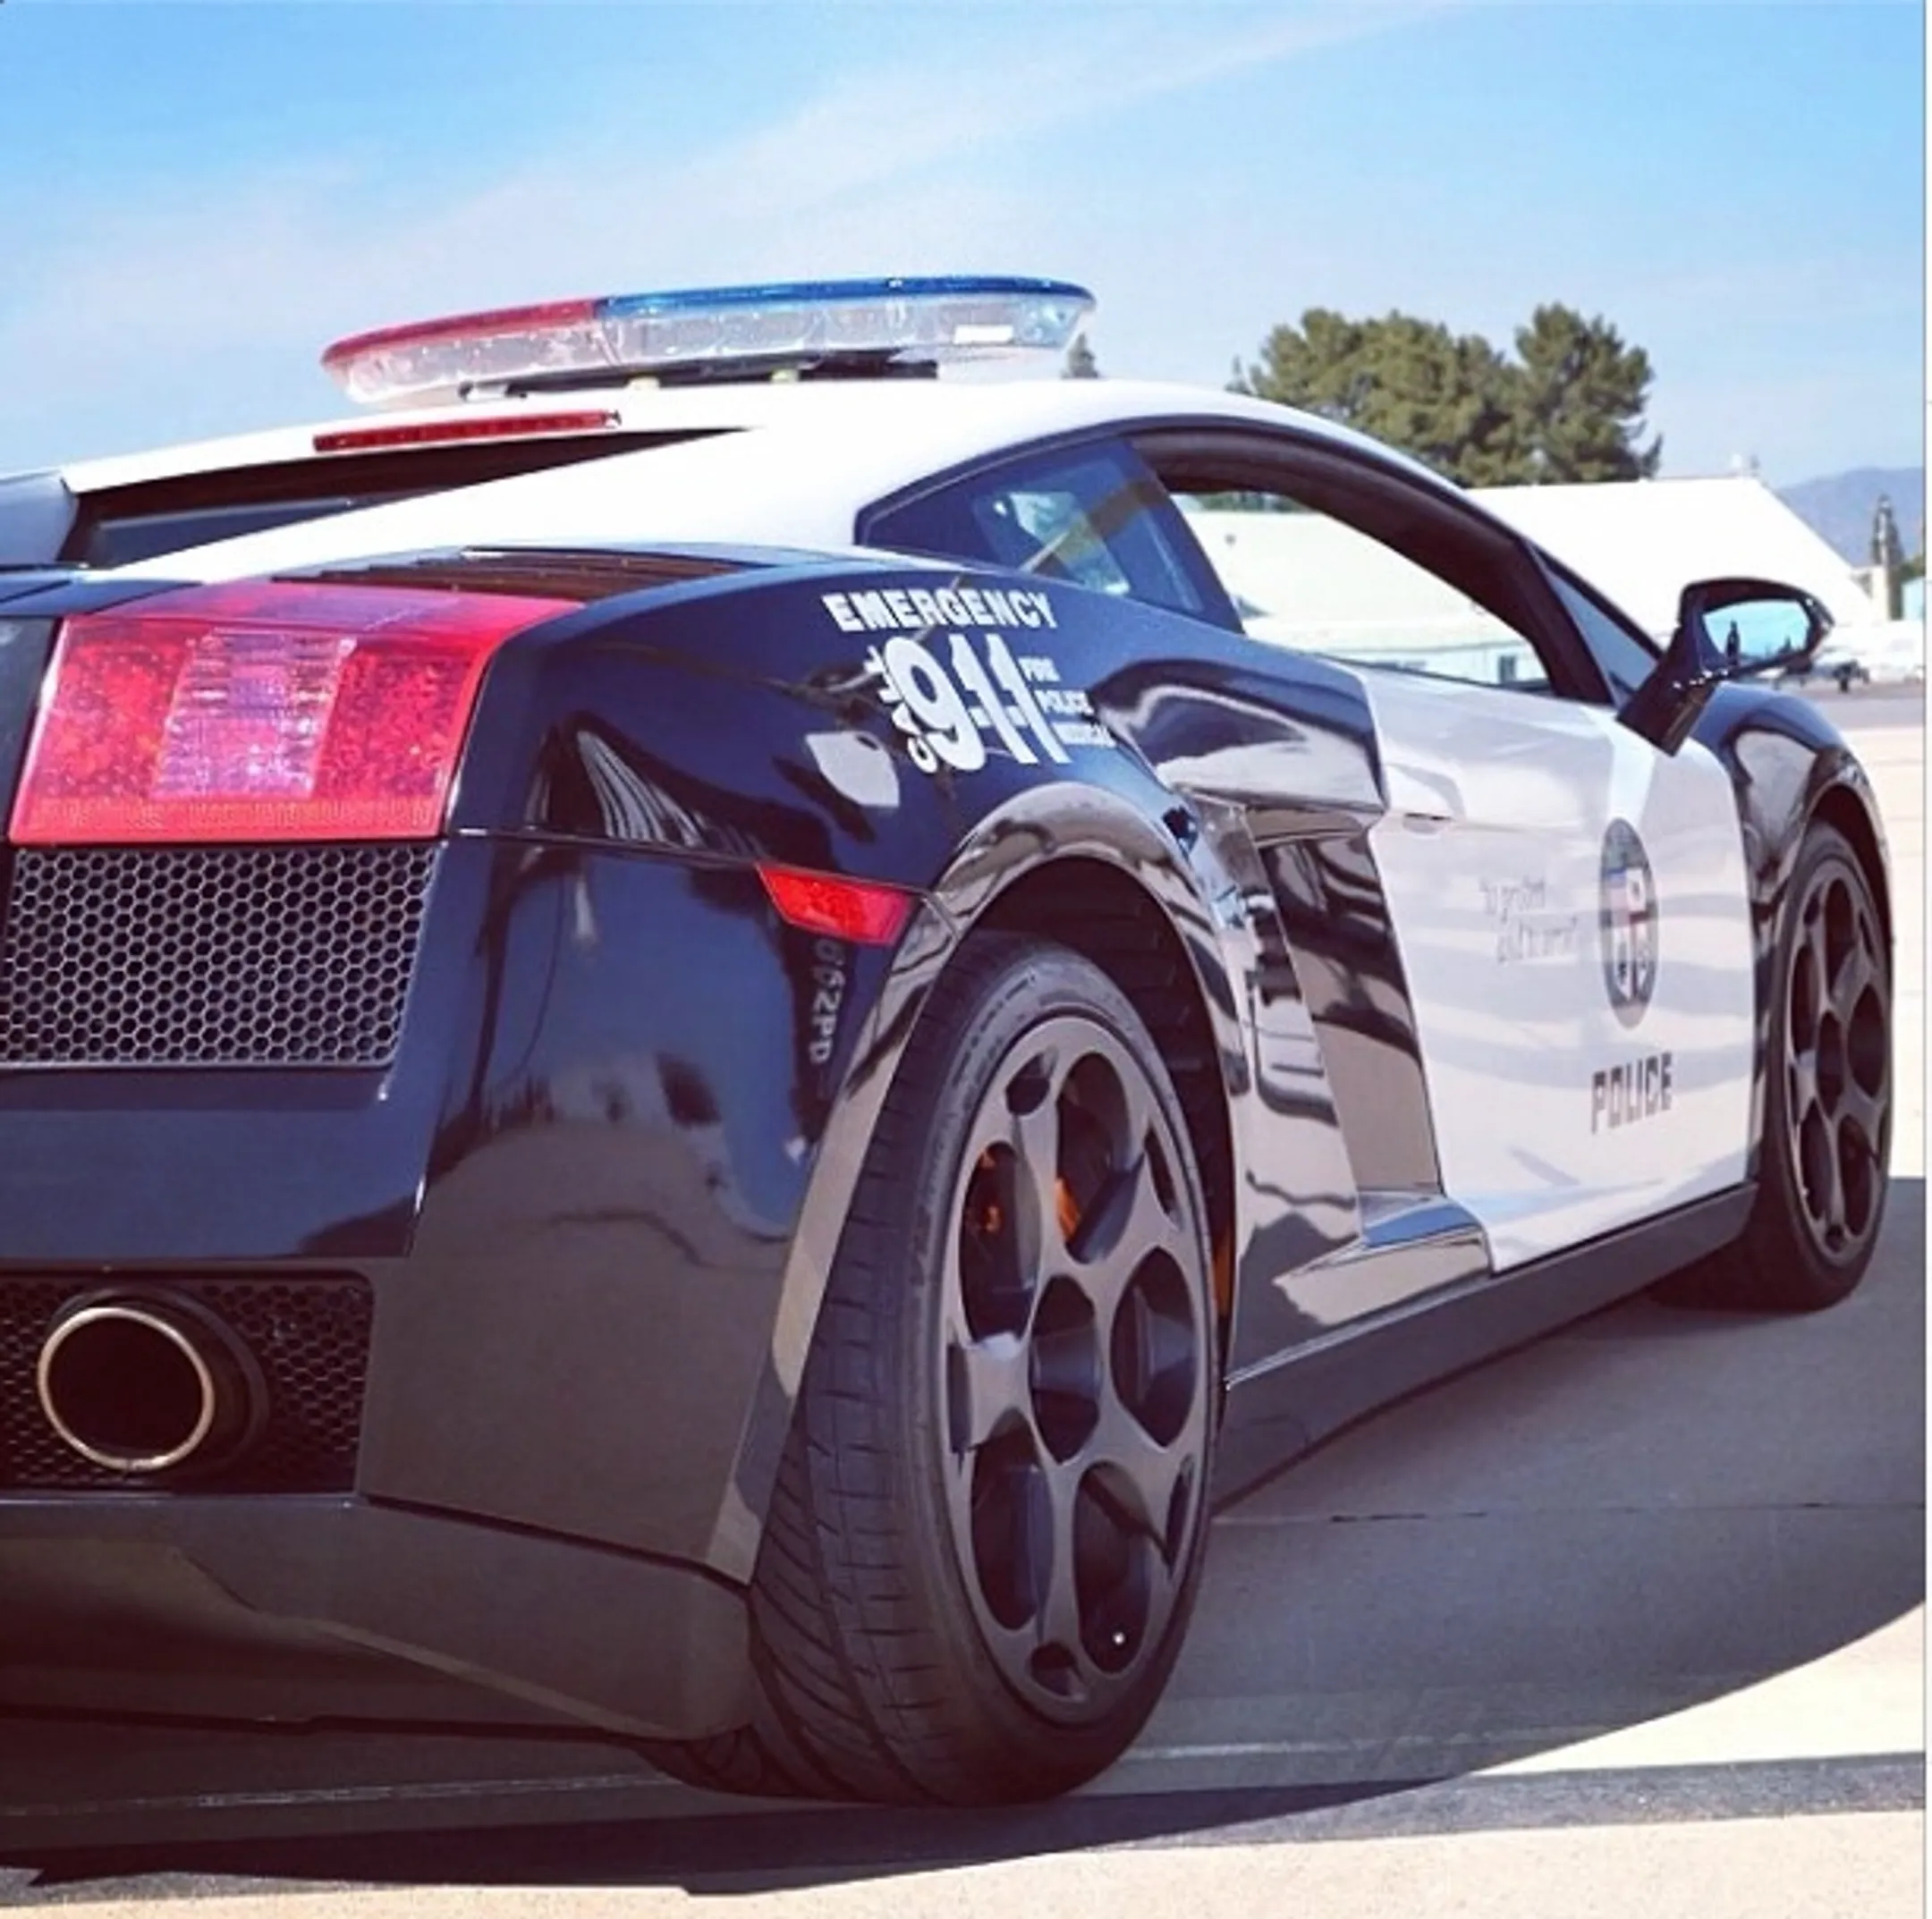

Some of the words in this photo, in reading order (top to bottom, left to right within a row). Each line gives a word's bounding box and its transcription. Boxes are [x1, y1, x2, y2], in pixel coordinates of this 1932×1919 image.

[822, 588, 1058, 631] EMERGENCY
[863, 646, 938, 774] CALL
[1590, 1051, 1674, 1135] POLICE
